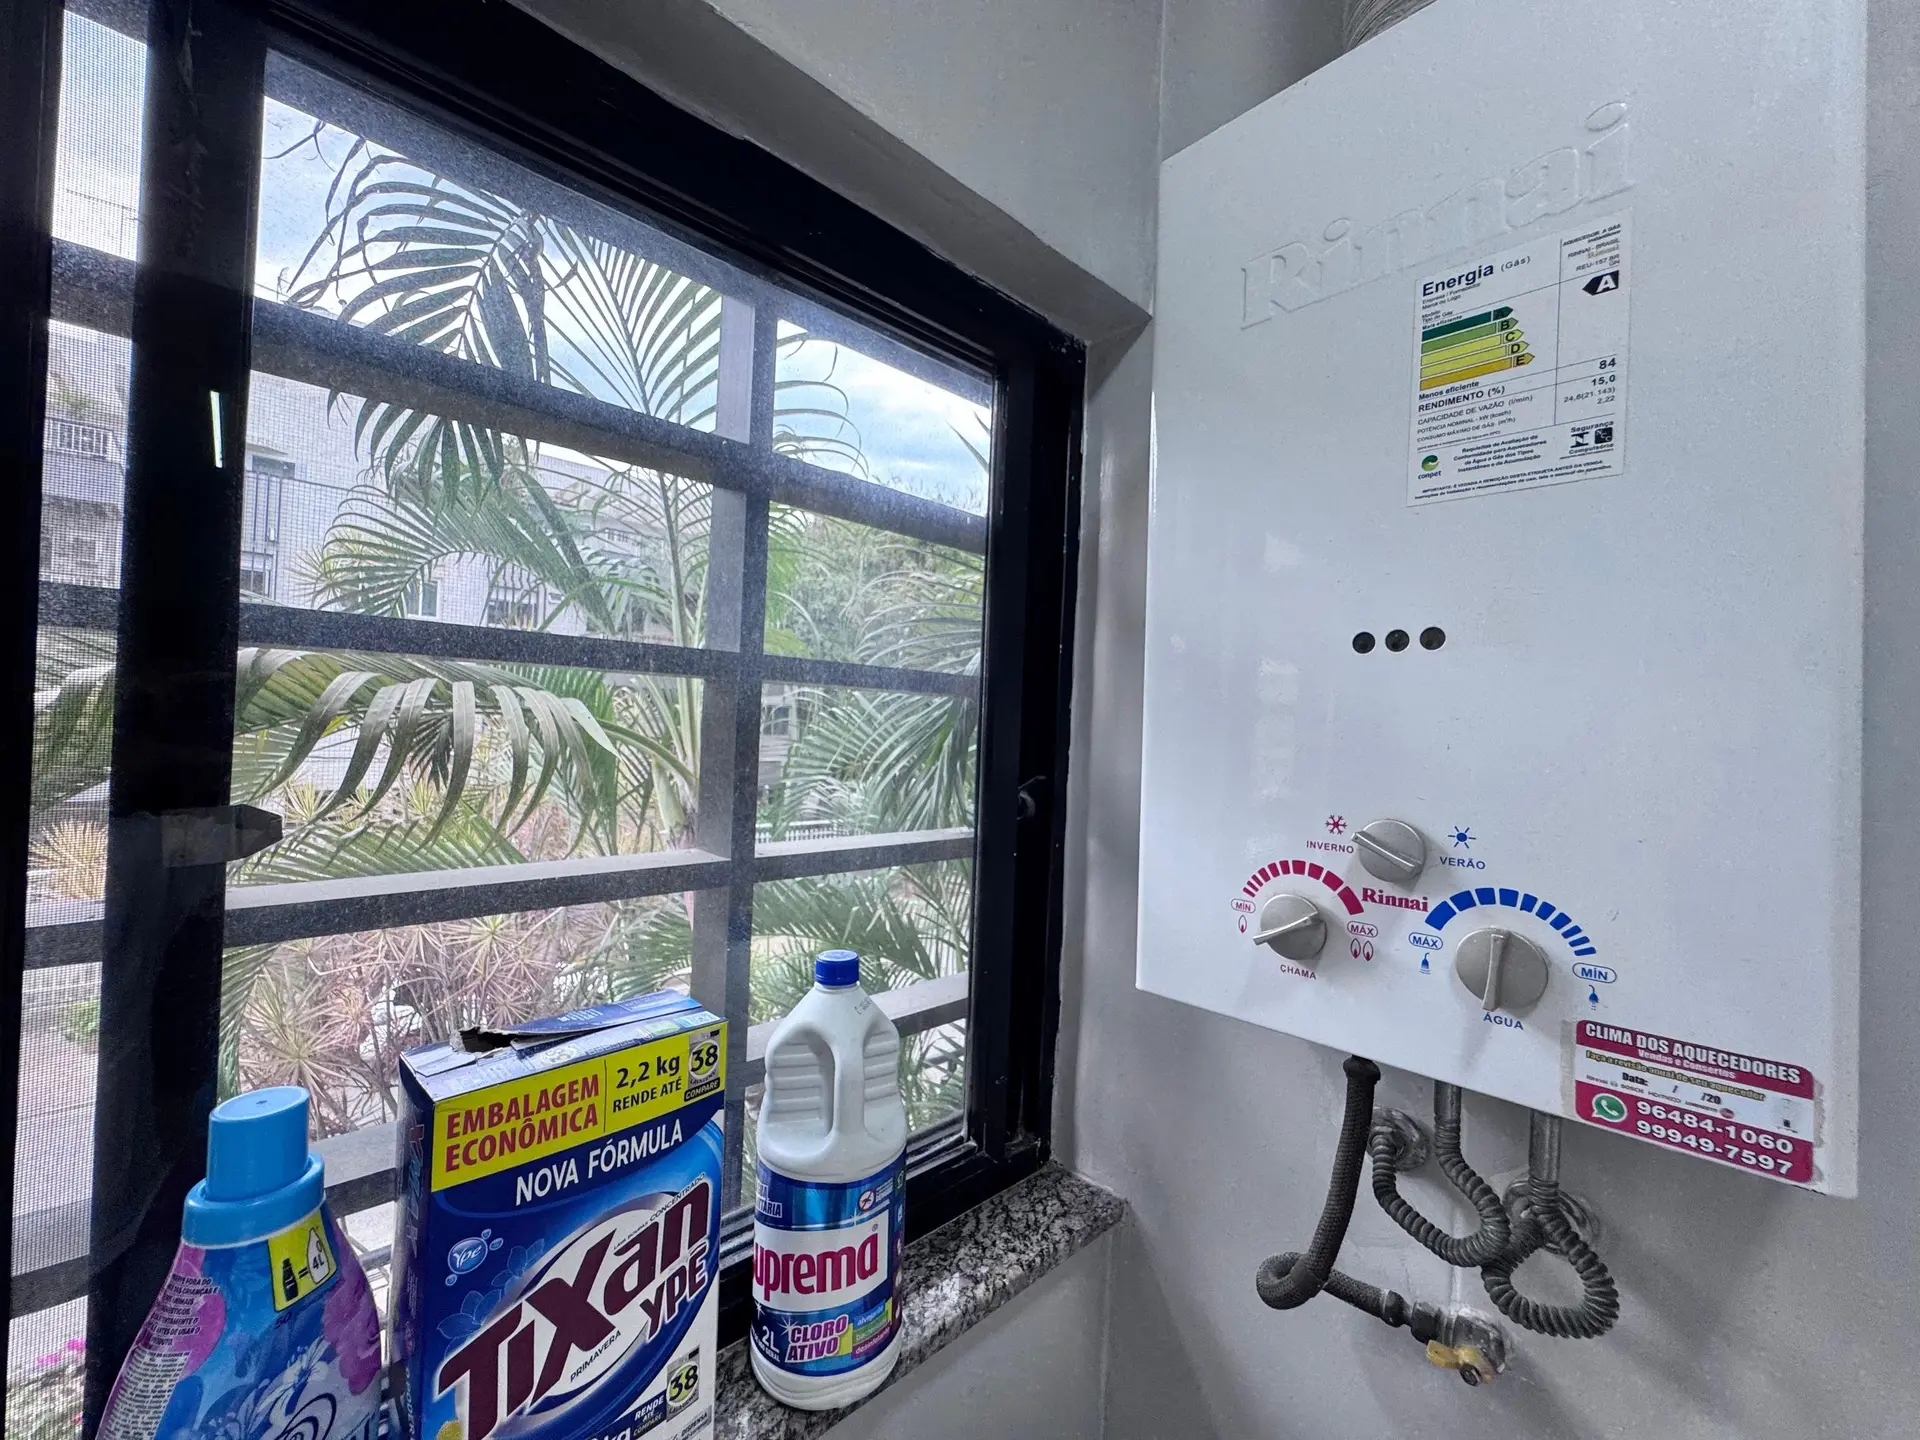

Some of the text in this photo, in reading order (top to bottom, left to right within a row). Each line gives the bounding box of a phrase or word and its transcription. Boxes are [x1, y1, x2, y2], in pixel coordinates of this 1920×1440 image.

[1242, 101, 1633, 330] Rinnai
[1596, 238, 1620, 250] BRASIL
[1422, 256, 1531, 297] Energia (Gás)
[1596, 274, 1618, 293] A
[1500, 320, 1510, 331] B
[1505, 331, 1515, 342] C
[1511, 343, 1520, 354] D
[1516, 355, 1525, 366] E
[1599, 358, 1617, 370] 84
[1418, 381, 1480, 401] Menos eficiente
[1591, 374, 1616, 387] 15,0
[1418, 385, 1506, 413] RENDIMENTO (%)
[1417, 409, 1464, 426] CAPACIDADE
[1465, 407, 1477, 415] DE
[1478, 401, 1505, 412] VAZÃO
[1416, 432, 1447, 443] CONSUMO
[1447, 427, 1471, 437] MÁXIMO
[1417, 423, 1447, 434] POTÊNCIA
[1447, 419, 1474, 428] NOMINAL
[1570, 420, 1614, 433] Segurança
[1568, 443, 1614, 455] Compulsório
[1417, 470, 1442, 480] conpet
[1305, 839, 1355, 855] INVERNO
[1439, 854, 1487, 871] VERÃO
[1234, 899, 1253, 914] MÍN
[1361, 886, 1429, 913] Rinnai
[1350, 921, 1375, 937] MÁX
[1412, 933, 1439, 950] MÁX
[1279, 963, 1317, 980] CHAMA
[1579, 963, 1609, 982] MÍN
[1483, 1011, 1524, 1031] ÁGUA
[690, 1044, 719, 1072] 38
[1585, 1022, 1801, 1084] CLIMA DOS AQUECEDORES
[616, 1061, 650, 1089] 2,2
[656, 1055, 680, 1077] kg
[1585, 1049, 1606, 1063] Faça
[1607, 1056, 1613, 1064] a
[1613, 1057, 1648, 1073] revisão
[1648, 1066, 1676, 1080] anual
[1676, 1071, 1689, 1083] de
[1689, 1076, 1708, 1087] seu
[1638, 1049, 1673, 1065] Vendas
[1683, 1059, 1737, 1080] Consertos
[685, 1079, 719, 1100] COMPARE
[1622, 1072, 1649, 1087] Data:
[612, 1087, 658, 1113] RENDE
[659, 1075, 683, 1098] ATÉ
[446, 1073, 600, 1140] EMBALAGEM
[445, 1103, 598, 1173] ECONÔMICA
[1636, 1101, 1793, 1154] 96484-1060
[1636, 1120, 1793, 1175] 99949-7597
[515, 1119, 684, 1207] NOVA FÓRMULA
[649, 1173, 706, 1222] CONCENTRADO
[312, 1253, 325, 1270] 4L
[753, 1232, 879, 1302] uprema
[638, 1241, 708, 1340] YPÊ
[761, 1325, 780, 1354] 2L
[790, 1315, 848, 1344] CLORO
[569, 1329, 622, 1384] PRIMAVERA
[786, 1337, 839, 1361] ATIVO
[669, 1364, 699, 1401] 38
[634, 1394, 665, 1421] RENDE
